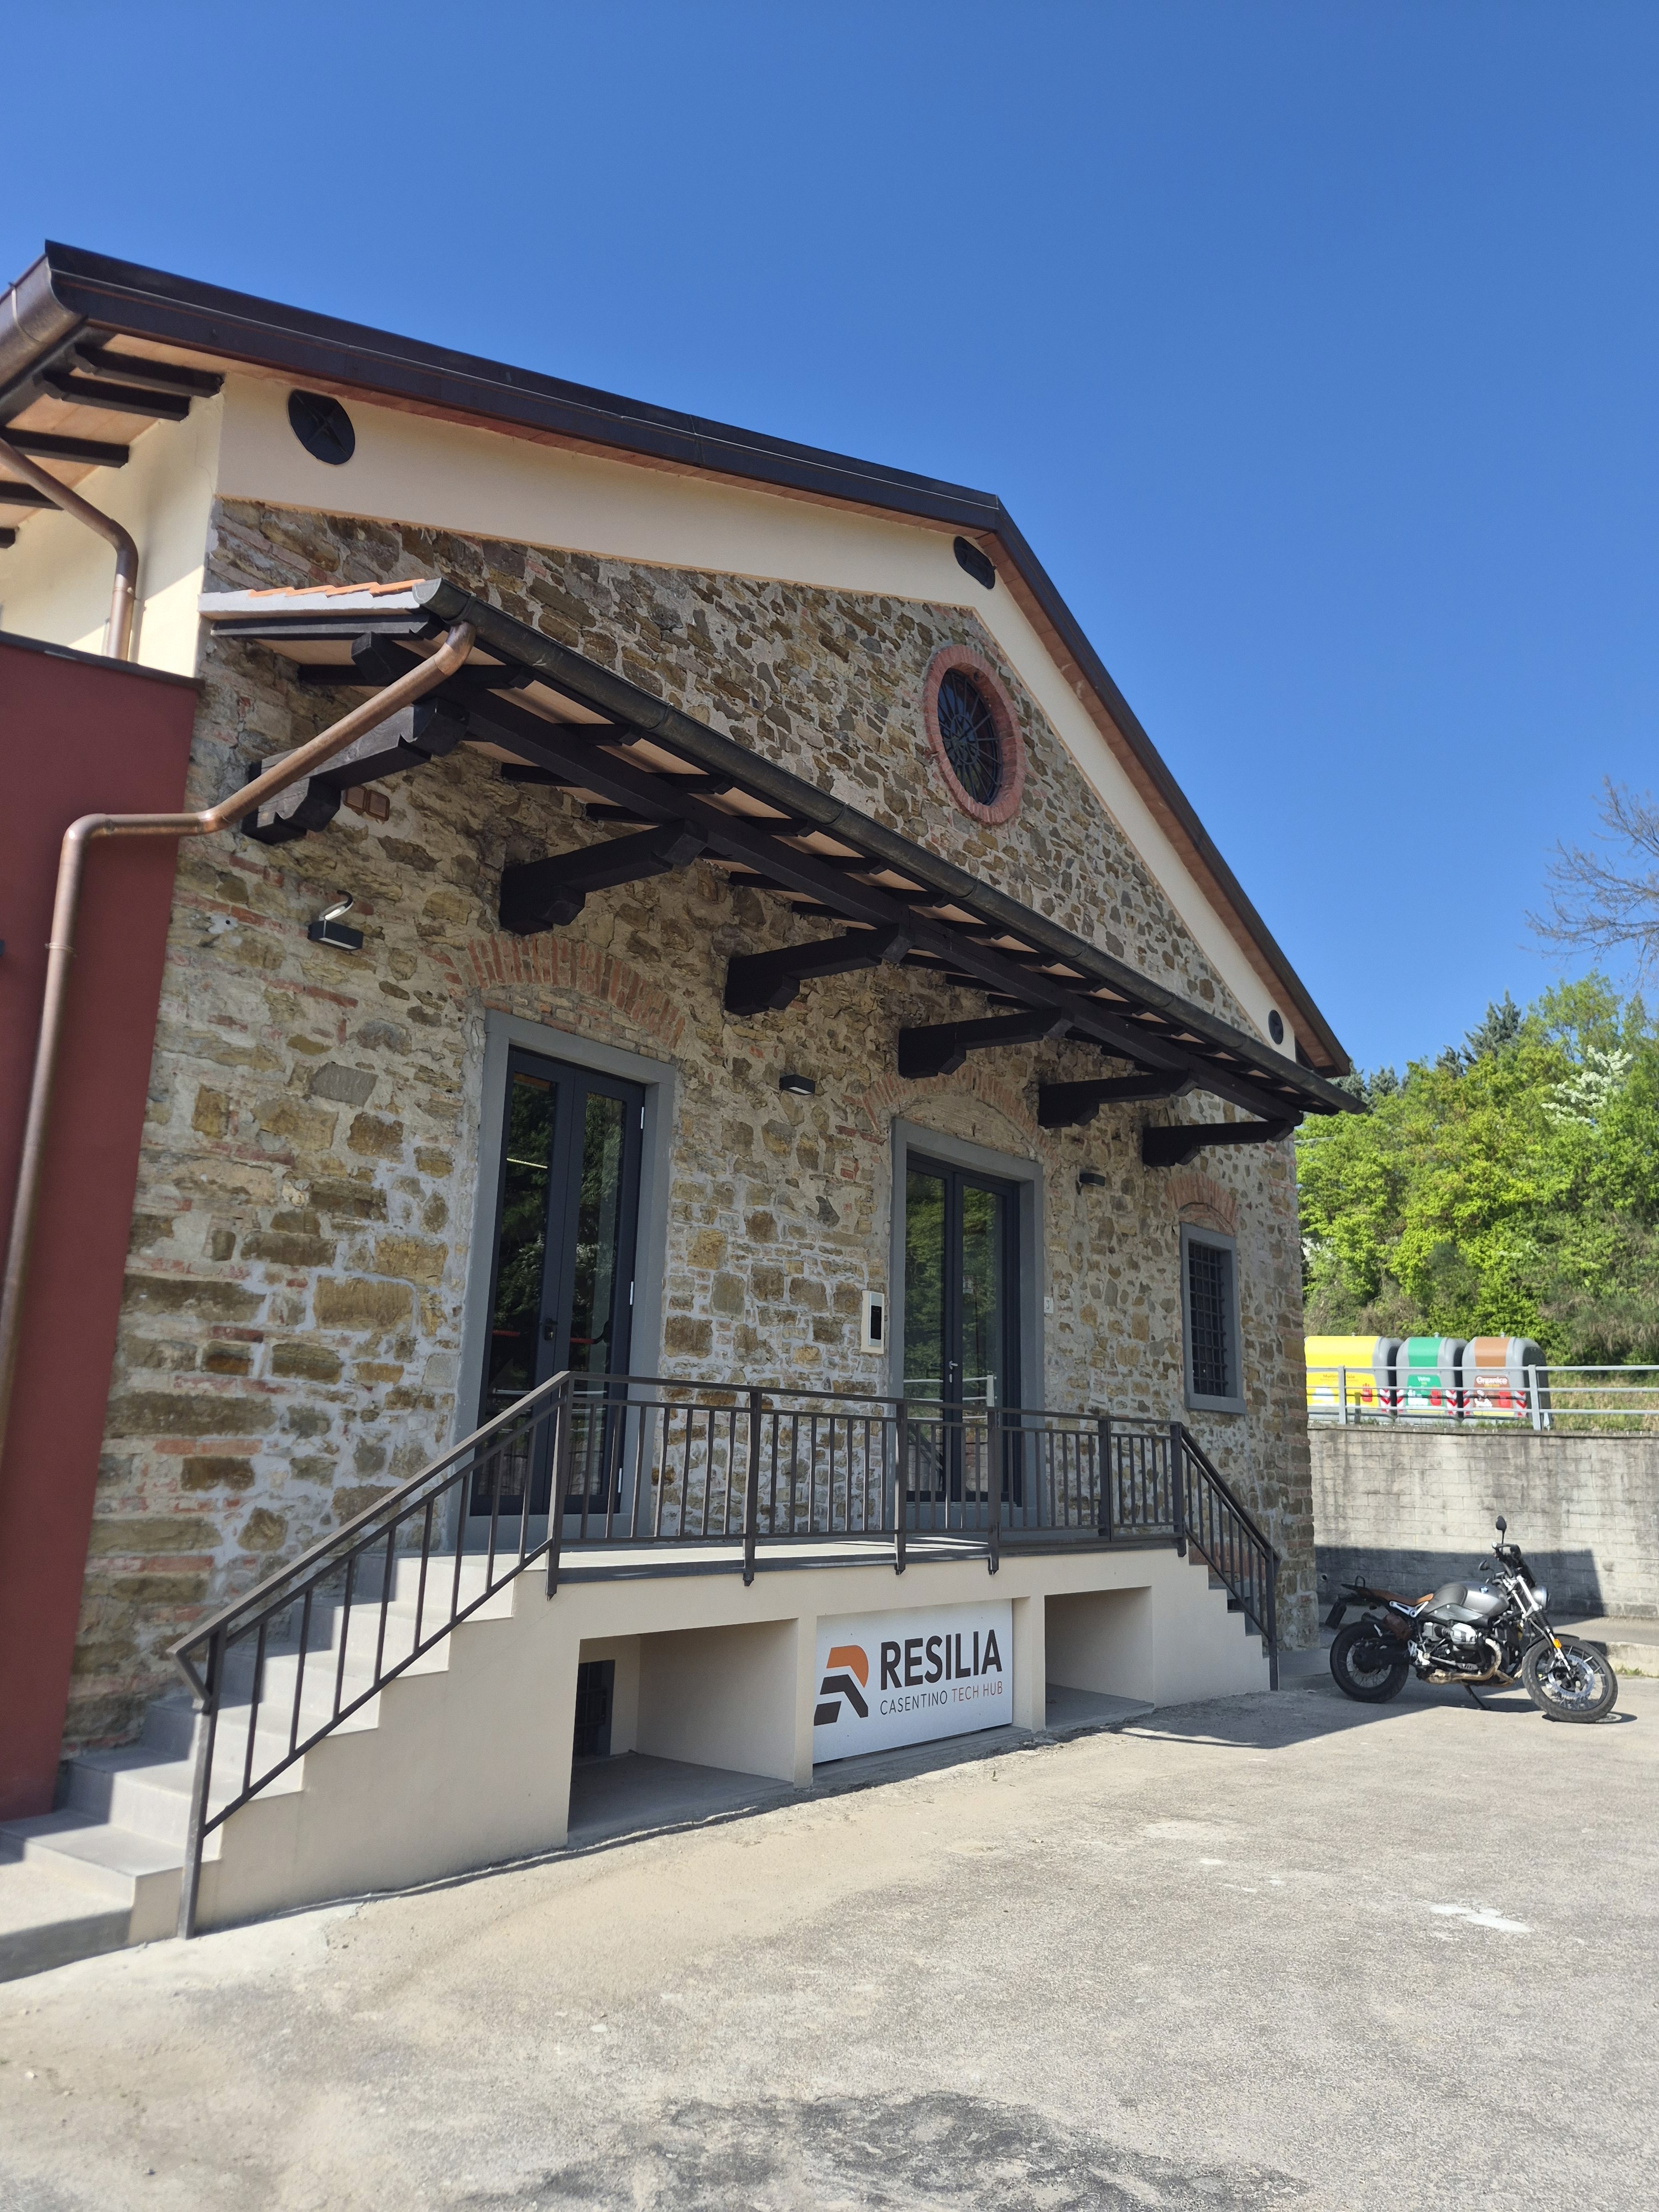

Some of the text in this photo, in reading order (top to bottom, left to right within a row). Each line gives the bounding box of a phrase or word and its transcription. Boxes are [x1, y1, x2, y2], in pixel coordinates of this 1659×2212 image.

[1476, 1376, 1507, 1385] Organico
[880, 1629, 1002, 1691] RESILIA
[880, 1681, 1003, 1715] CASENTINO TECH HUB
